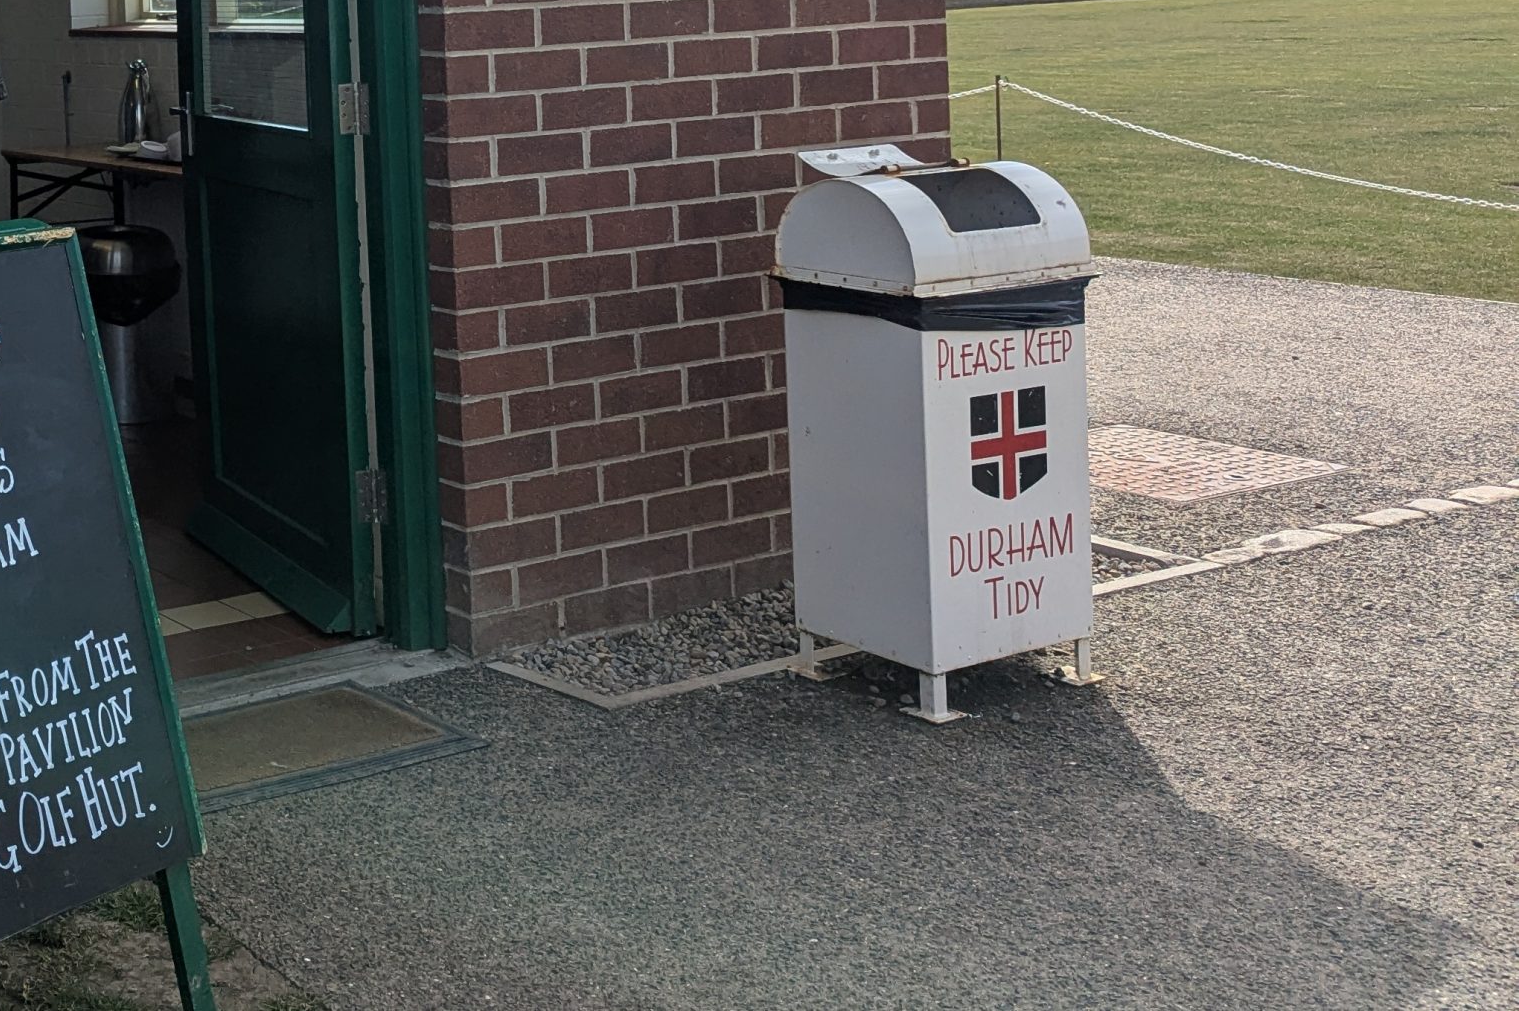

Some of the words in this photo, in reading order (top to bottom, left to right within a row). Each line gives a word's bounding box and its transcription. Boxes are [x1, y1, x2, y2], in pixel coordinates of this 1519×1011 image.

[938, 338, 1015, 381] PLEASE
[1024, 328, 1073, 368] KEEP
[950, 513, 1073, 577] DURHAM
[984, 576, 1044, 619] TIDY
[74, 630, 137, 690] THE
[76, 762, 157, 839] HUT.
